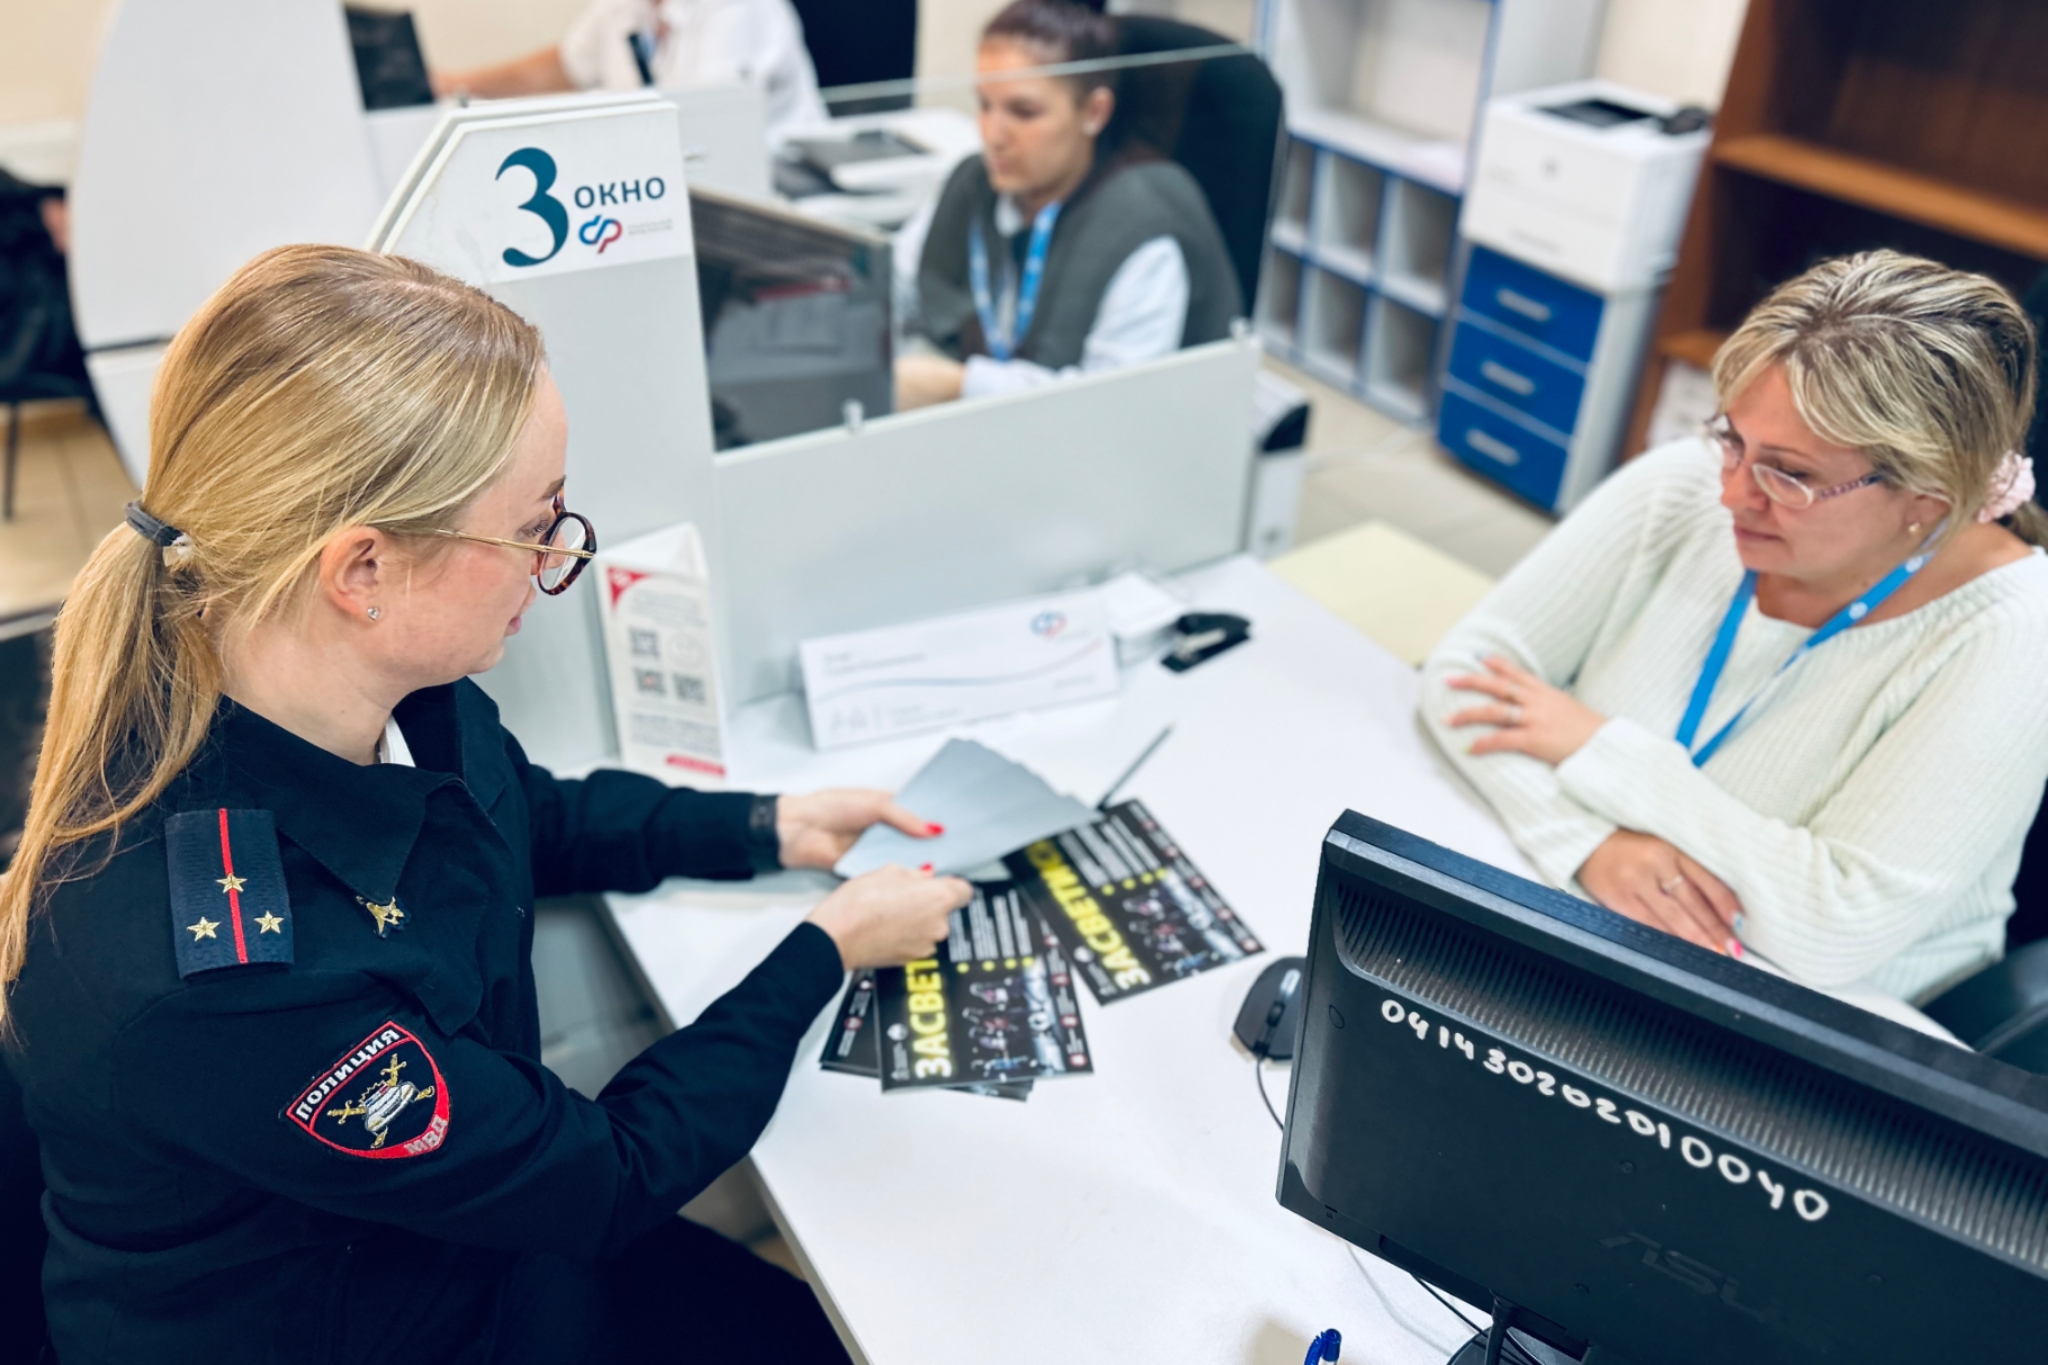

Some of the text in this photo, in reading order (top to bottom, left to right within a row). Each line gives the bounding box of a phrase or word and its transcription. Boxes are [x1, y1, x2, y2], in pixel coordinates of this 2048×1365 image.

[495, 147, 665, 267] 3 ОКНО
[906, 959, 952, 1079] ЗАСВЕТ
[296, 1029, 400, 1120] ПОЛИЦИЯ
[404, 1114, 447, 1154] МВД
